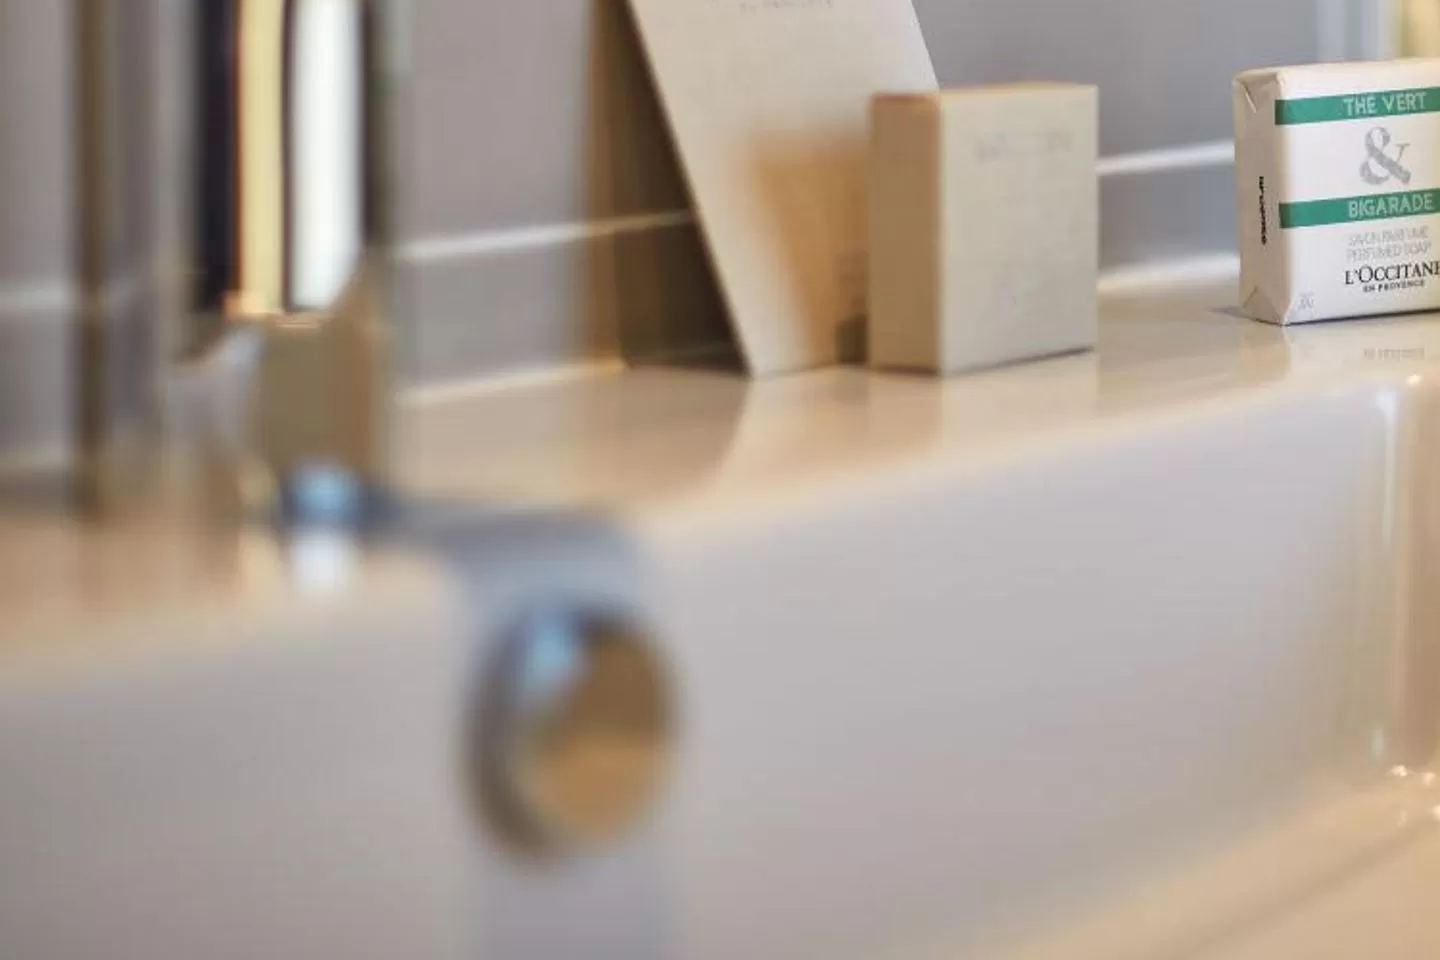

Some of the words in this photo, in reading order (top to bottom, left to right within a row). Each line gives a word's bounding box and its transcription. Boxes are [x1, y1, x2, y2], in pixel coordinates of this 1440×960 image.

[1382, 91, 1427, 113] VERT
[1359, 126, 1411, 184] &
[1348, 193, 1434, 218] BIGARADE
